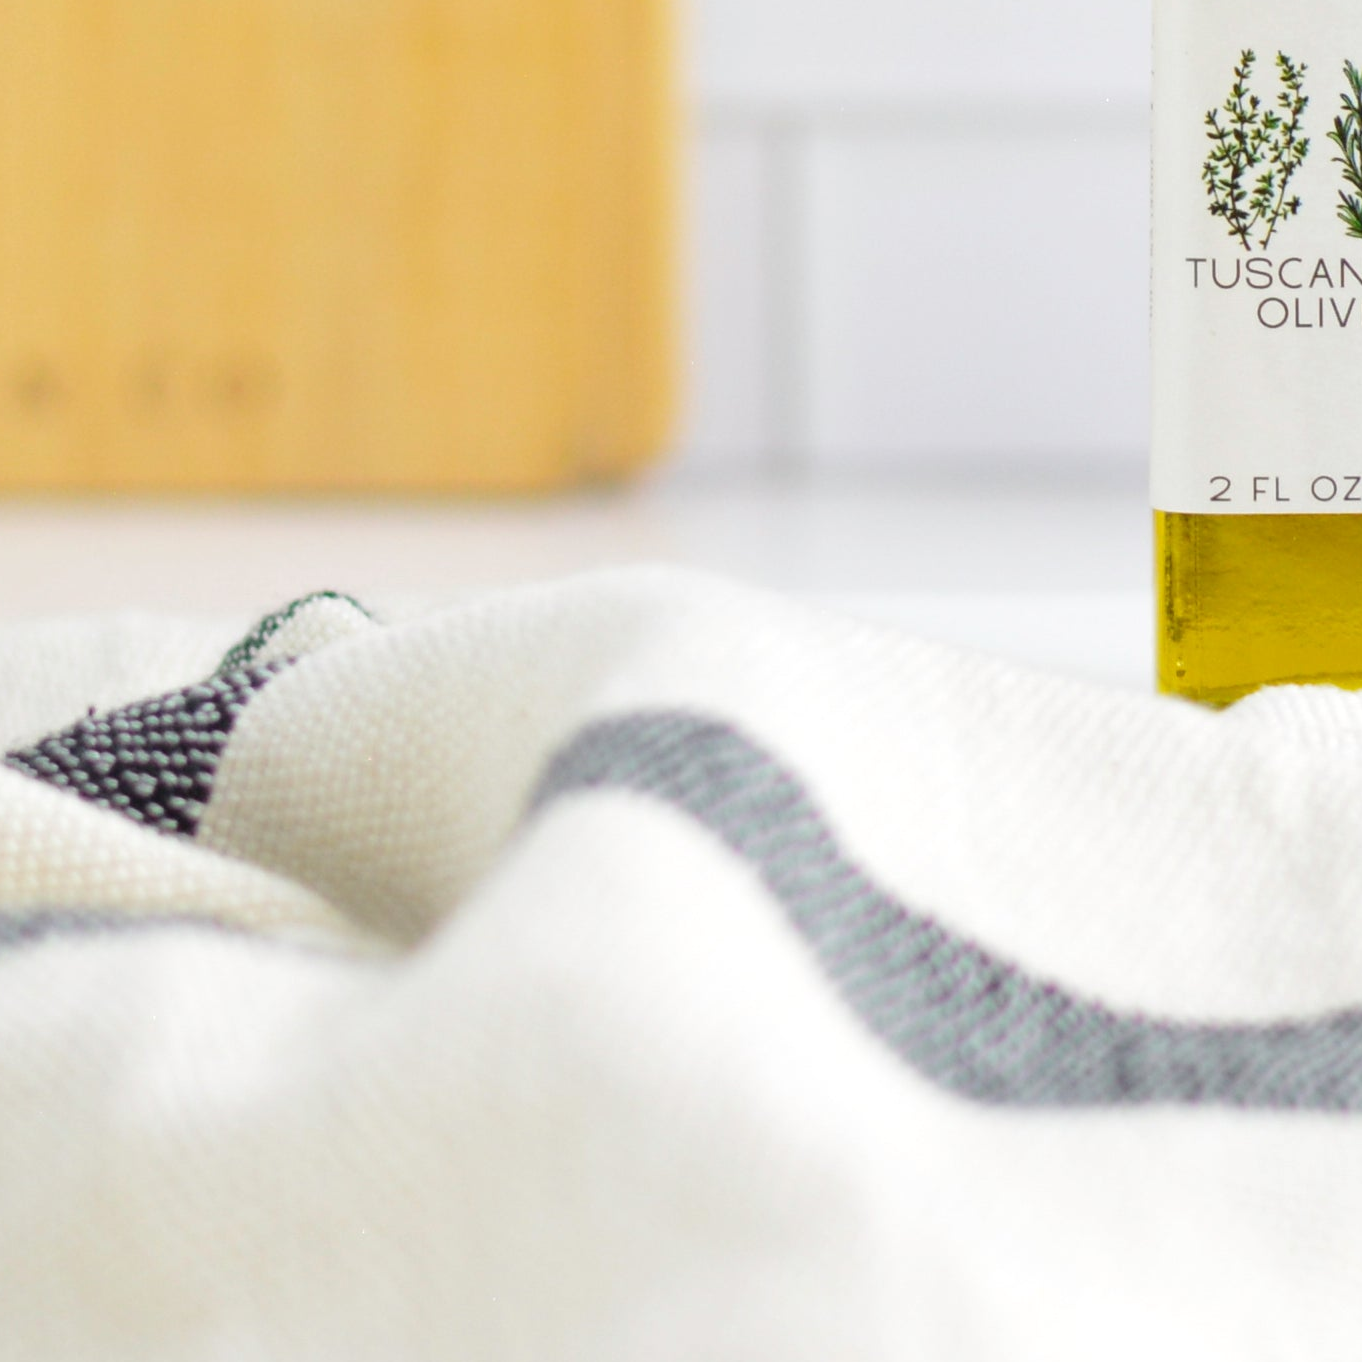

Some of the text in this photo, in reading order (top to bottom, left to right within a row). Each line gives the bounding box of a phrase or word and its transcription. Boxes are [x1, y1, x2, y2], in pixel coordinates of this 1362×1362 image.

[1209, 475, 1232, 502] 2
[1252, 476, 1291, 502] FL
[1310, 475, 1362, 503] OZ
